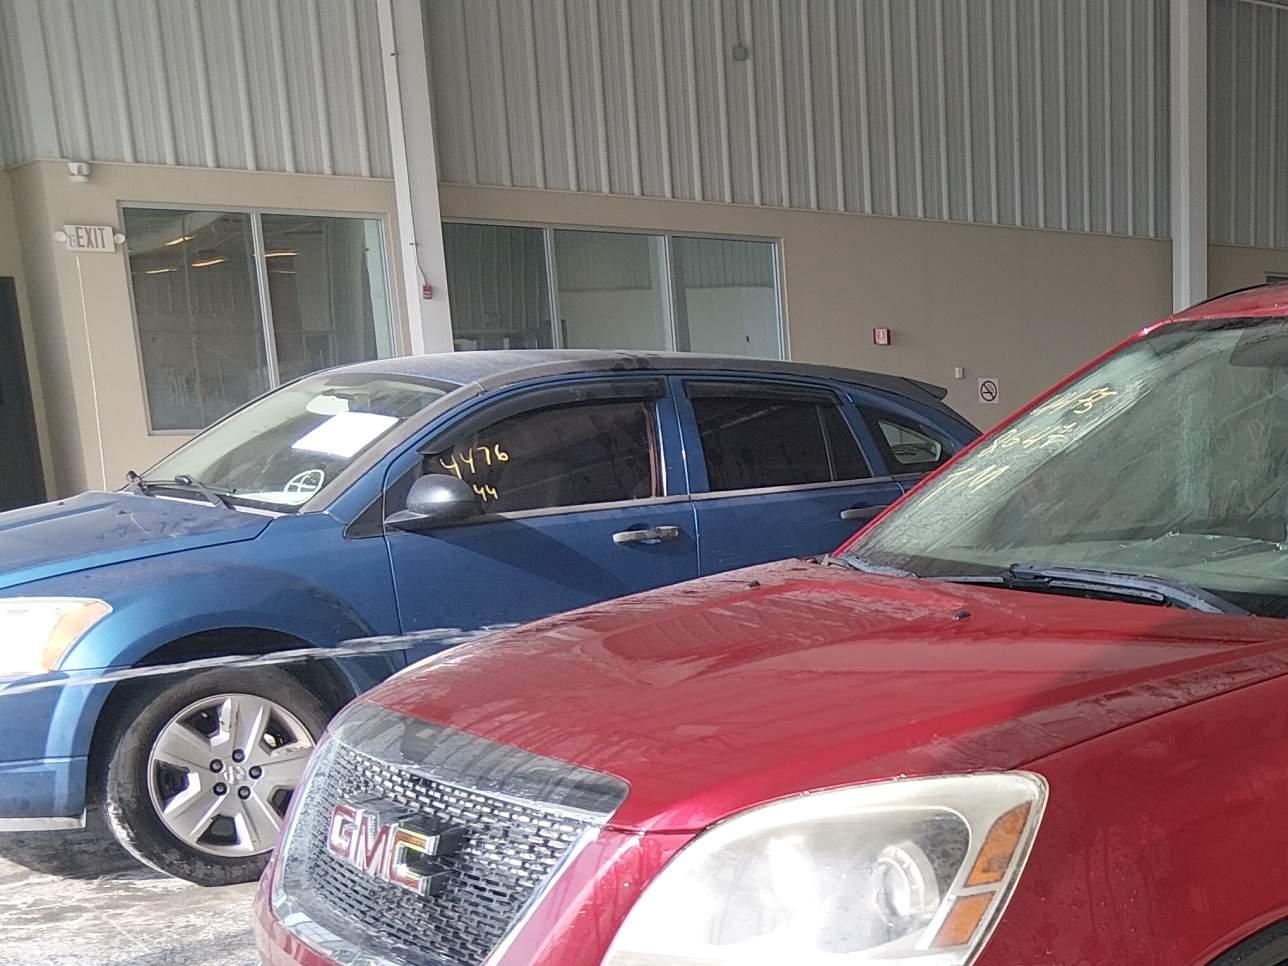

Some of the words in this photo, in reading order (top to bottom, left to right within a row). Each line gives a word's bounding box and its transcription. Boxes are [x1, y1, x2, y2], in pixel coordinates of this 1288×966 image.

[75, 226, 106, 249] EXIT
[439, 443, 510, 480] 4476
[326, 803, 441, 898] GMC
